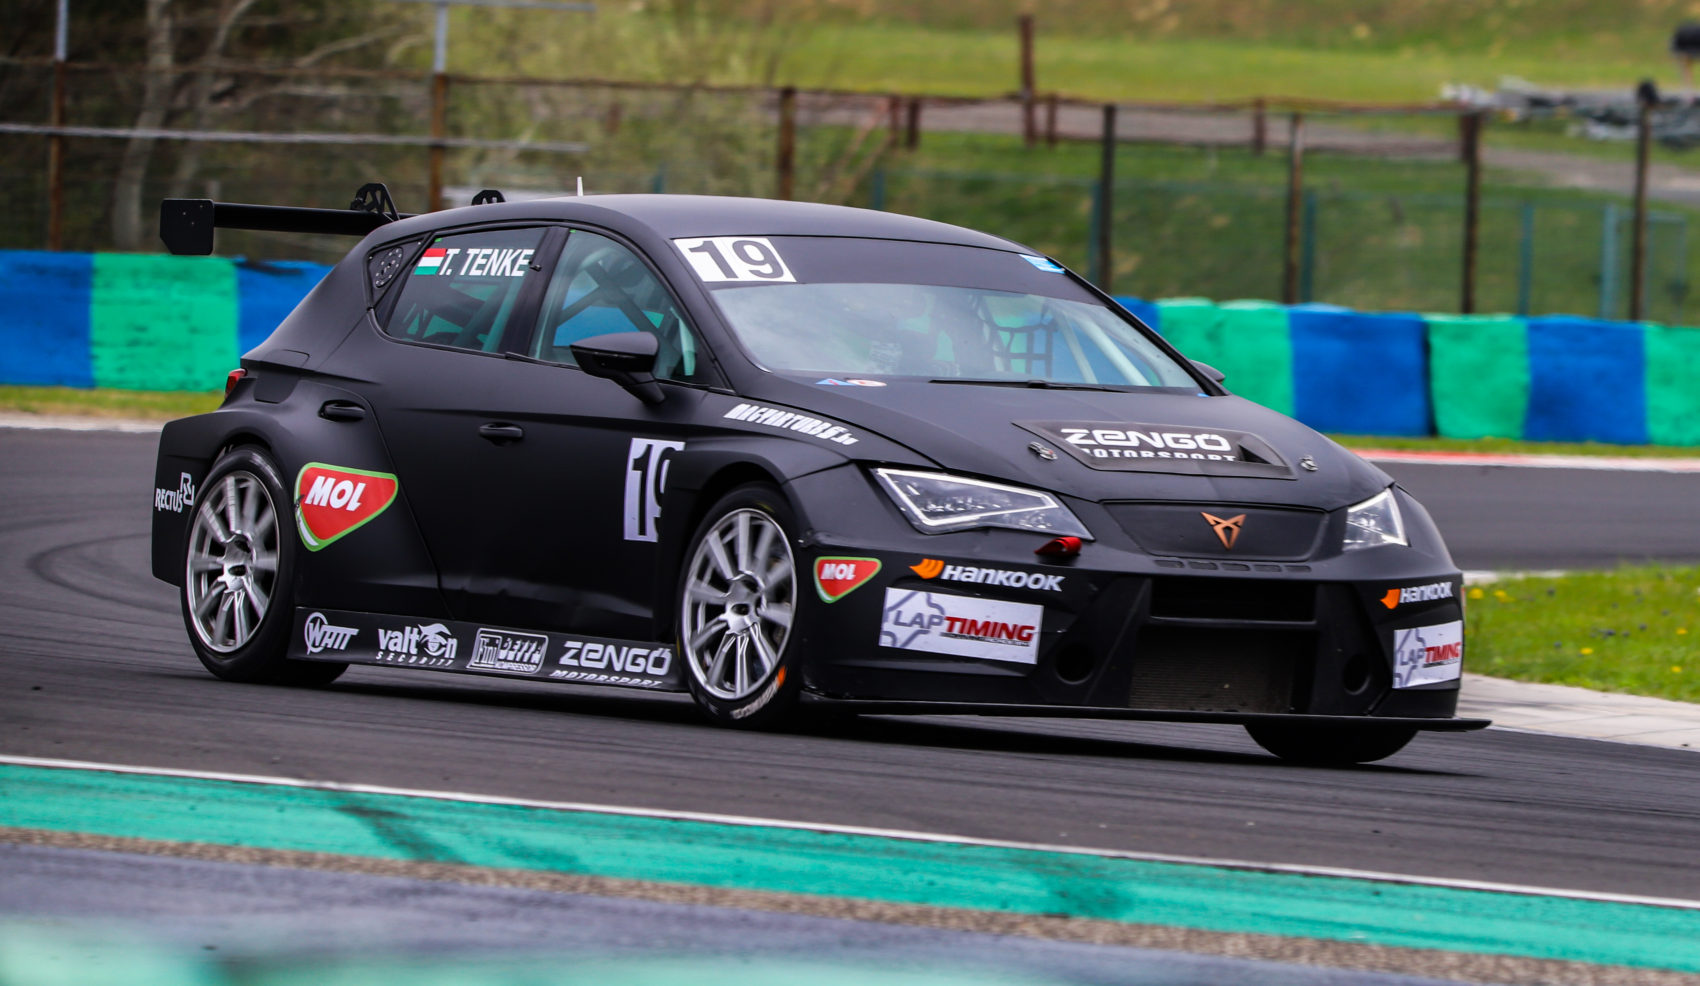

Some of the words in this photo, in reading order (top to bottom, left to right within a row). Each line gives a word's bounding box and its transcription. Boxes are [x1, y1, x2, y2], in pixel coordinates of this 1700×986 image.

[439, 248, 461, 276] T.
[459, 248, 535, 277] TENKE
[687, 240, 784, 279] 19
[155, 488, 183, 513] RECTUS
[304, 475, 366, 512] MOL
[820, 563, 857, 581] MOL
[375, 651, 454, 666] SECURITY
[550, 670, 663, 687] MOTORSPORT
